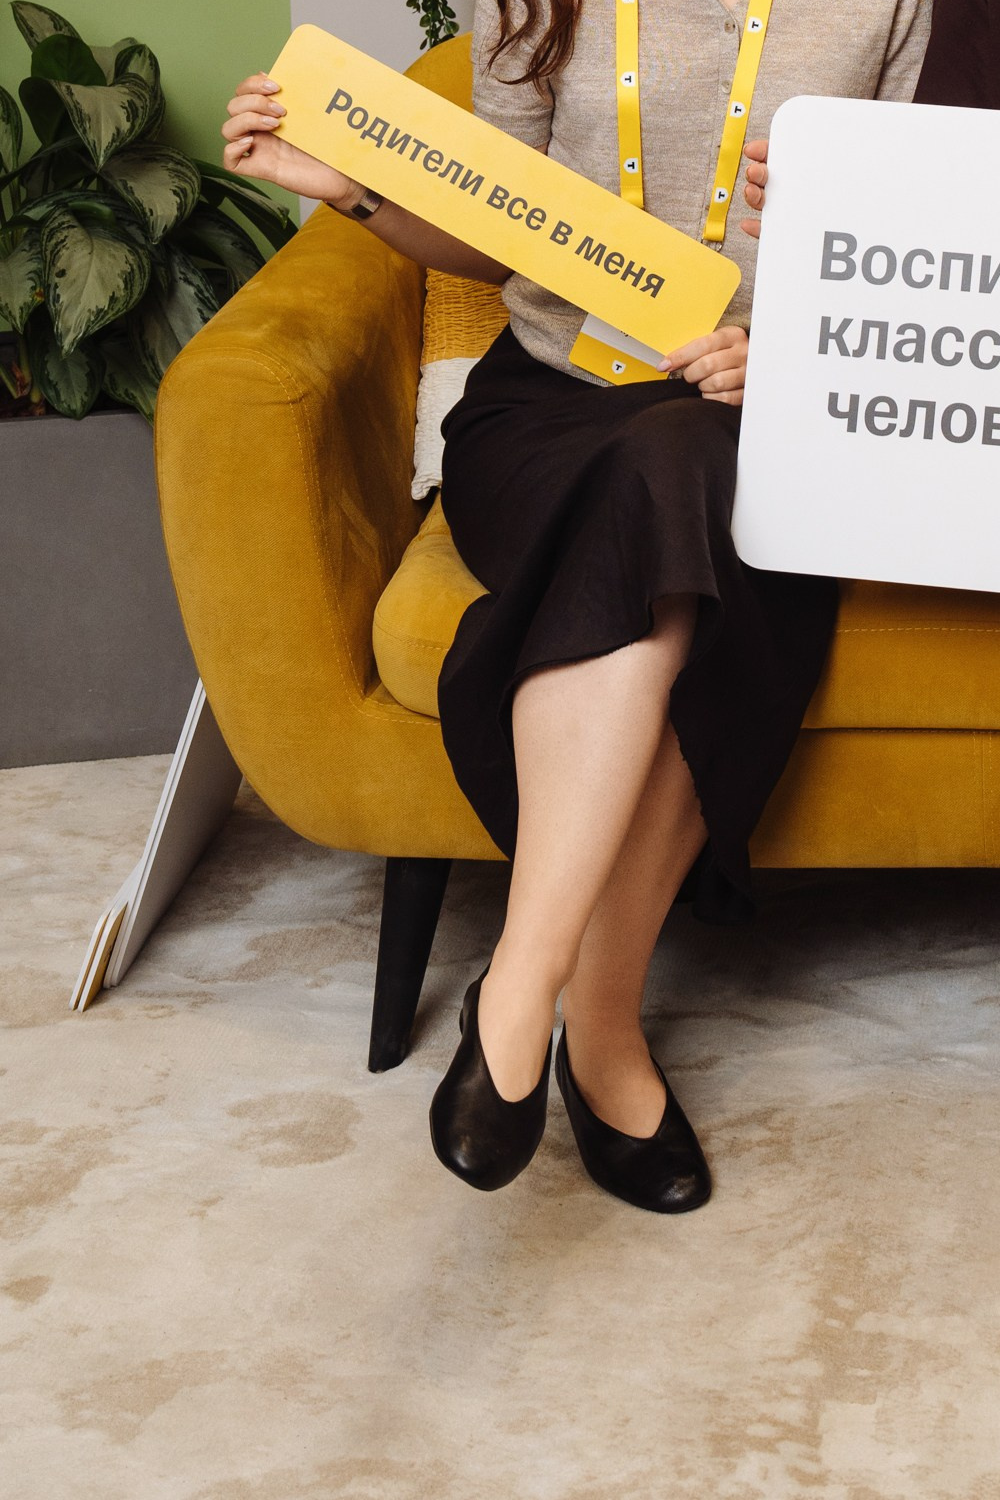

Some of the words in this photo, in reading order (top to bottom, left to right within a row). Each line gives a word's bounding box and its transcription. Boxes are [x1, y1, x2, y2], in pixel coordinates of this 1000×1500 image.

[326, 89, 486, 197] Родители
[487, 184, 547, 231] все
[550, 220, 573, 246] в
[575, 235, 666, 299] меня
